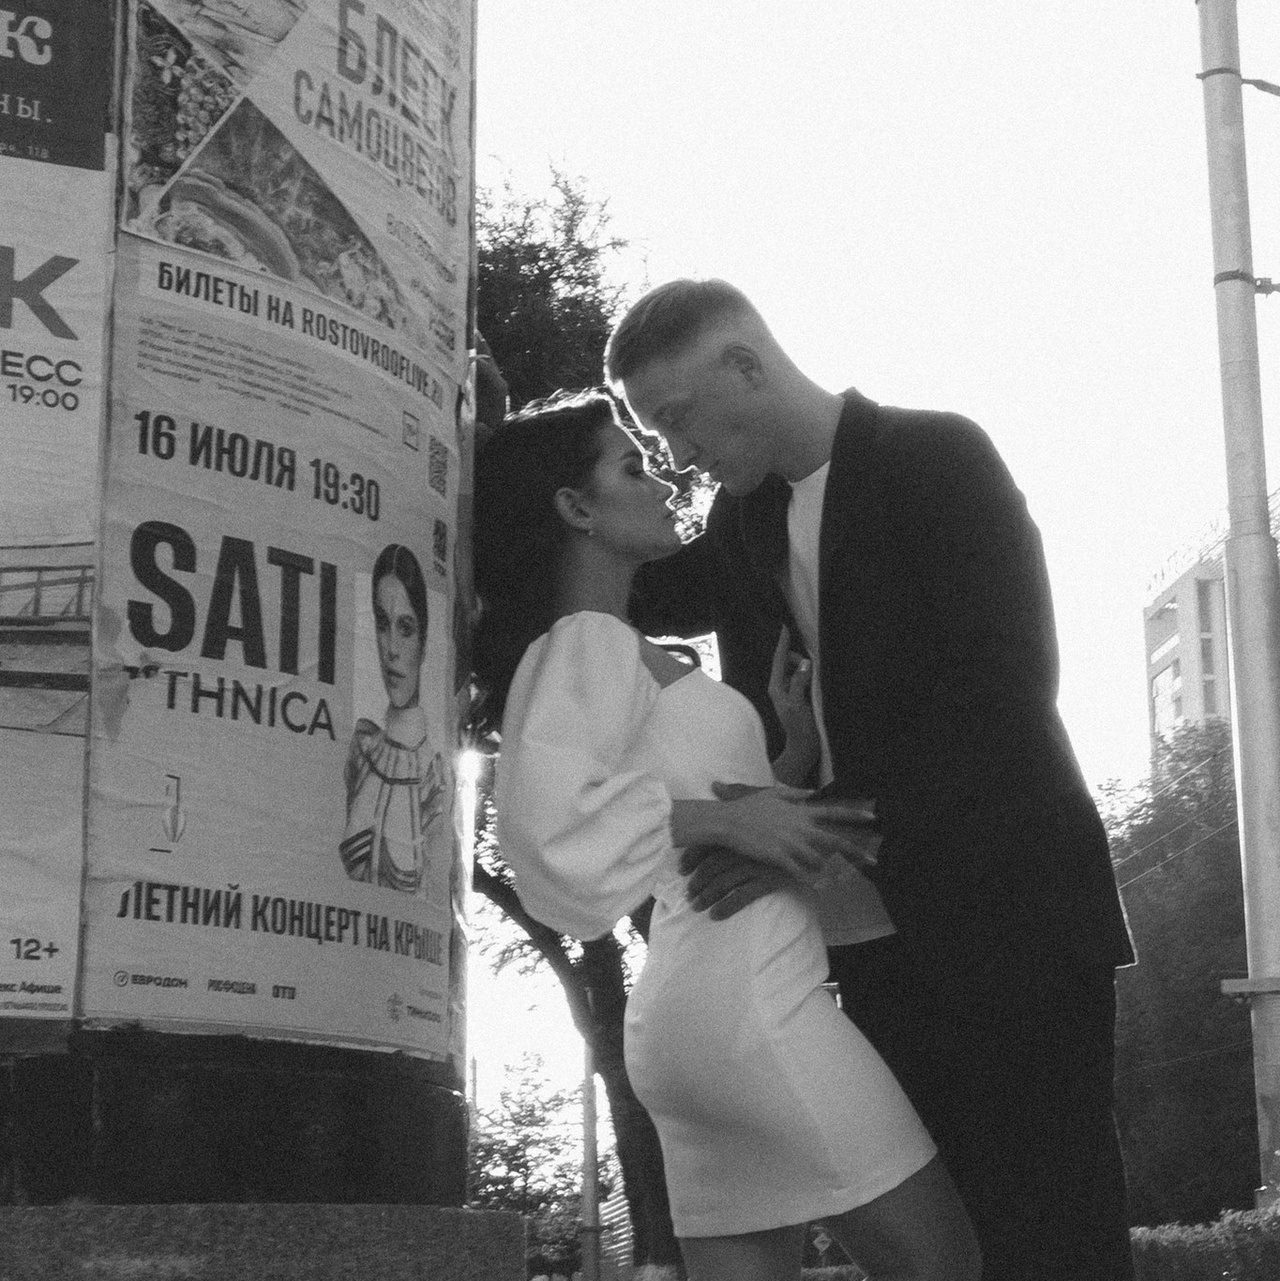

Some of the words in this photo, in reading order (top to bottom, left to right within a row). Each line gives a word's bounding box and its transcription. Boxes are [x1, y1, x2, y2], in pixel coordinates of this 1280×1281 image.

[157, 261, 260, 317] БИЛЕТЫ
[266, 294, 296, 329] НА
[6, 383, 80, 412] 19:00
[133, 410, 178, 461] 16
[188, 421, 297, 492] ИЮЛЯ
[308, 457, 381, 522] 19:30
[127, 520, 338, 686] SATI
[122, 664, 337, 742] THNICA
[9, 937, 60, 961] 12+
[116, 880, 242, 930] ЛЕТНИЙ
[251, 894, 362, 946] КОНЦЕРТ
[366, 913, 391, 953] НА
[394, 918, 444, 967] КРЫШЕ
